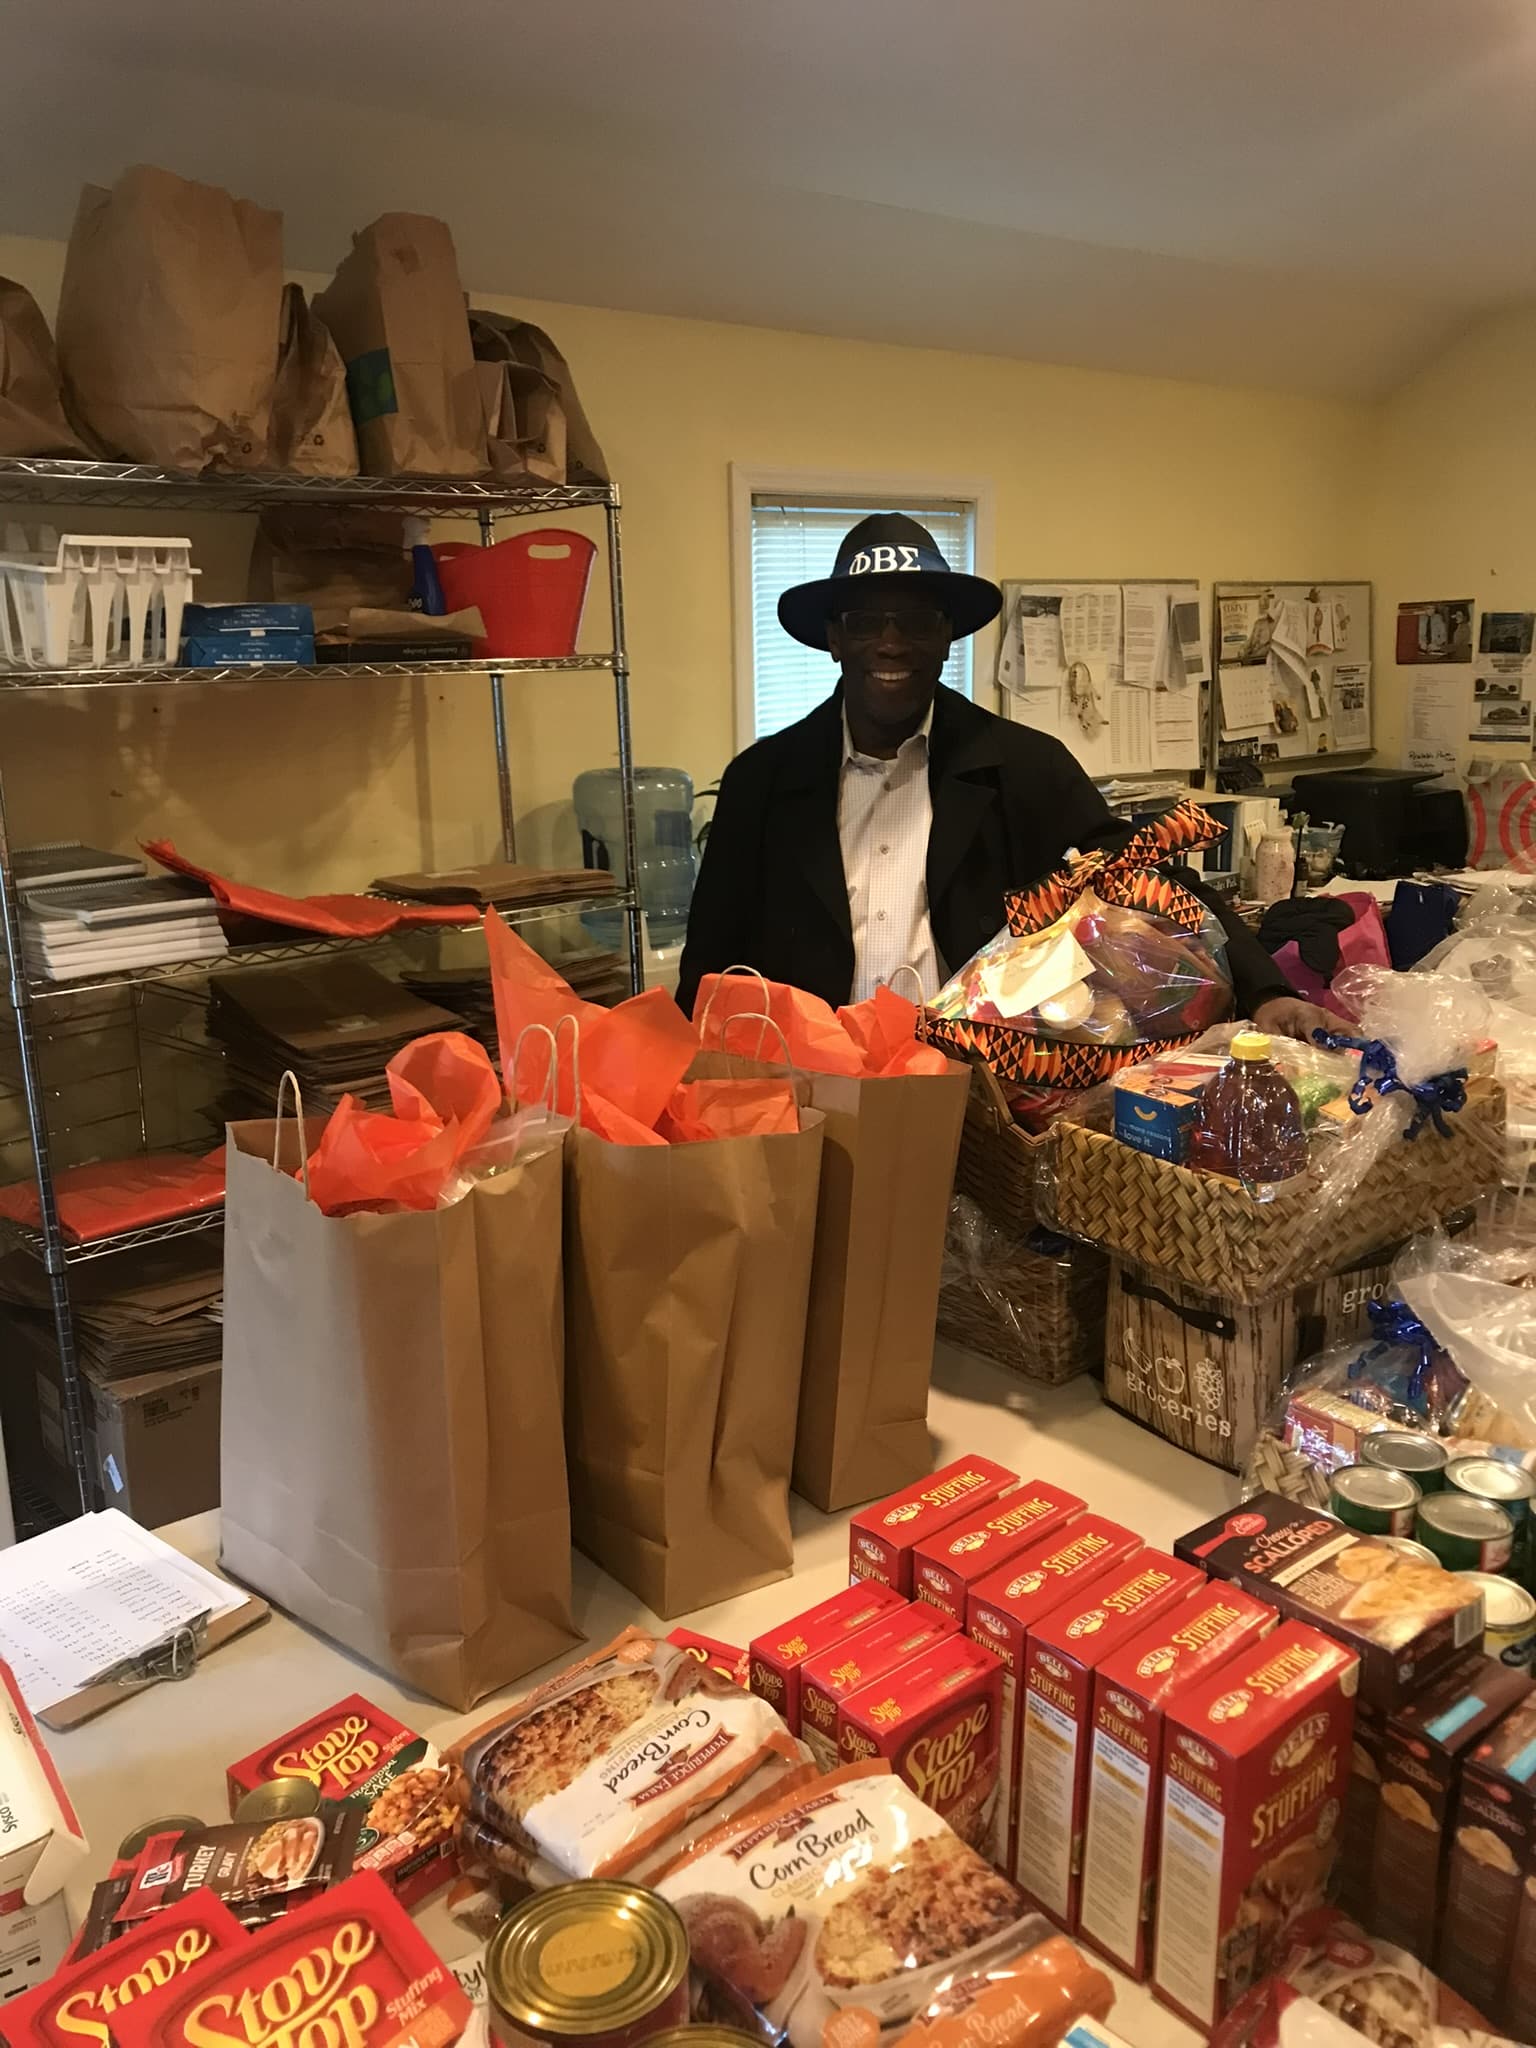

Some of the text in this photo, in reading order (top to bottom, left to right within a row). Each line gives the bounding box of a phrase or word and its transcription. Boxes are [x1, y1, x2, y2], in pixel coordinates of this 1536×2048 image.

[1126, 1370, 1232, 1437] groceries
[920, 1470, 986, 1506] STUFFING
[986, 1497, 1054, 1535] STUFFING
[1041, 1532, 1109, 1575] STUFFING
[1244, 1521, 1334, 1573] SCALLOPED
[1102, 1568, 1171, 1614] STUFFING
[971, 1627, 1014, 1668] STUFFING
[1171, 1602, 1241, 1651] STUFFING
[752, 1662, 784, 1688] Stove
[763, 1683, 779, 1700] Top
[1030, 1667, 1076, 1712] STUFFING
[1245, 1643, 1320, 1695] STUFFING
[803, 1688, 838, 1714] Stove
[815, 1706, 832, 1727] Top
[273, 1716, 368, 1788] Stove
[603, 1709, 711, 1795] Corn Bread
[841, 1725, 877, 1754] Stove
[906, 1703, 990, 1801] Stove
[1099, 1706, 1149, 1754] STUFFING
[323, 1739, 379, 1790] Top
[350, 1759, 398, 1799] TRADITIONAL
[364, 1770, 397, 1799] SAGE
[638, 1735, 729, 1801] PEPPERIDGE FARM
[931, 1751, 975, 1810] Top
[1170, 1752, 1222, 1804] STUFFING
[1251, 1745, 1337, 1848] STUFFING
[734, 1796, 832, 1855] PEPPERIDGE FARM
[749, 1808, 875, 1890] Corn Bread
[182, 1845, 217, 1892] TURKEY
[55, 1928, 212, 2048] Stove
[184, 1921, 376, 2048] Stove
[386, 1966, 443, 2019] Stuffing
[248, 1983, 380, 2048] Top
[399, 1998, 427, 2027] Mix
[966, 1994, 1033, 2042] Bread
